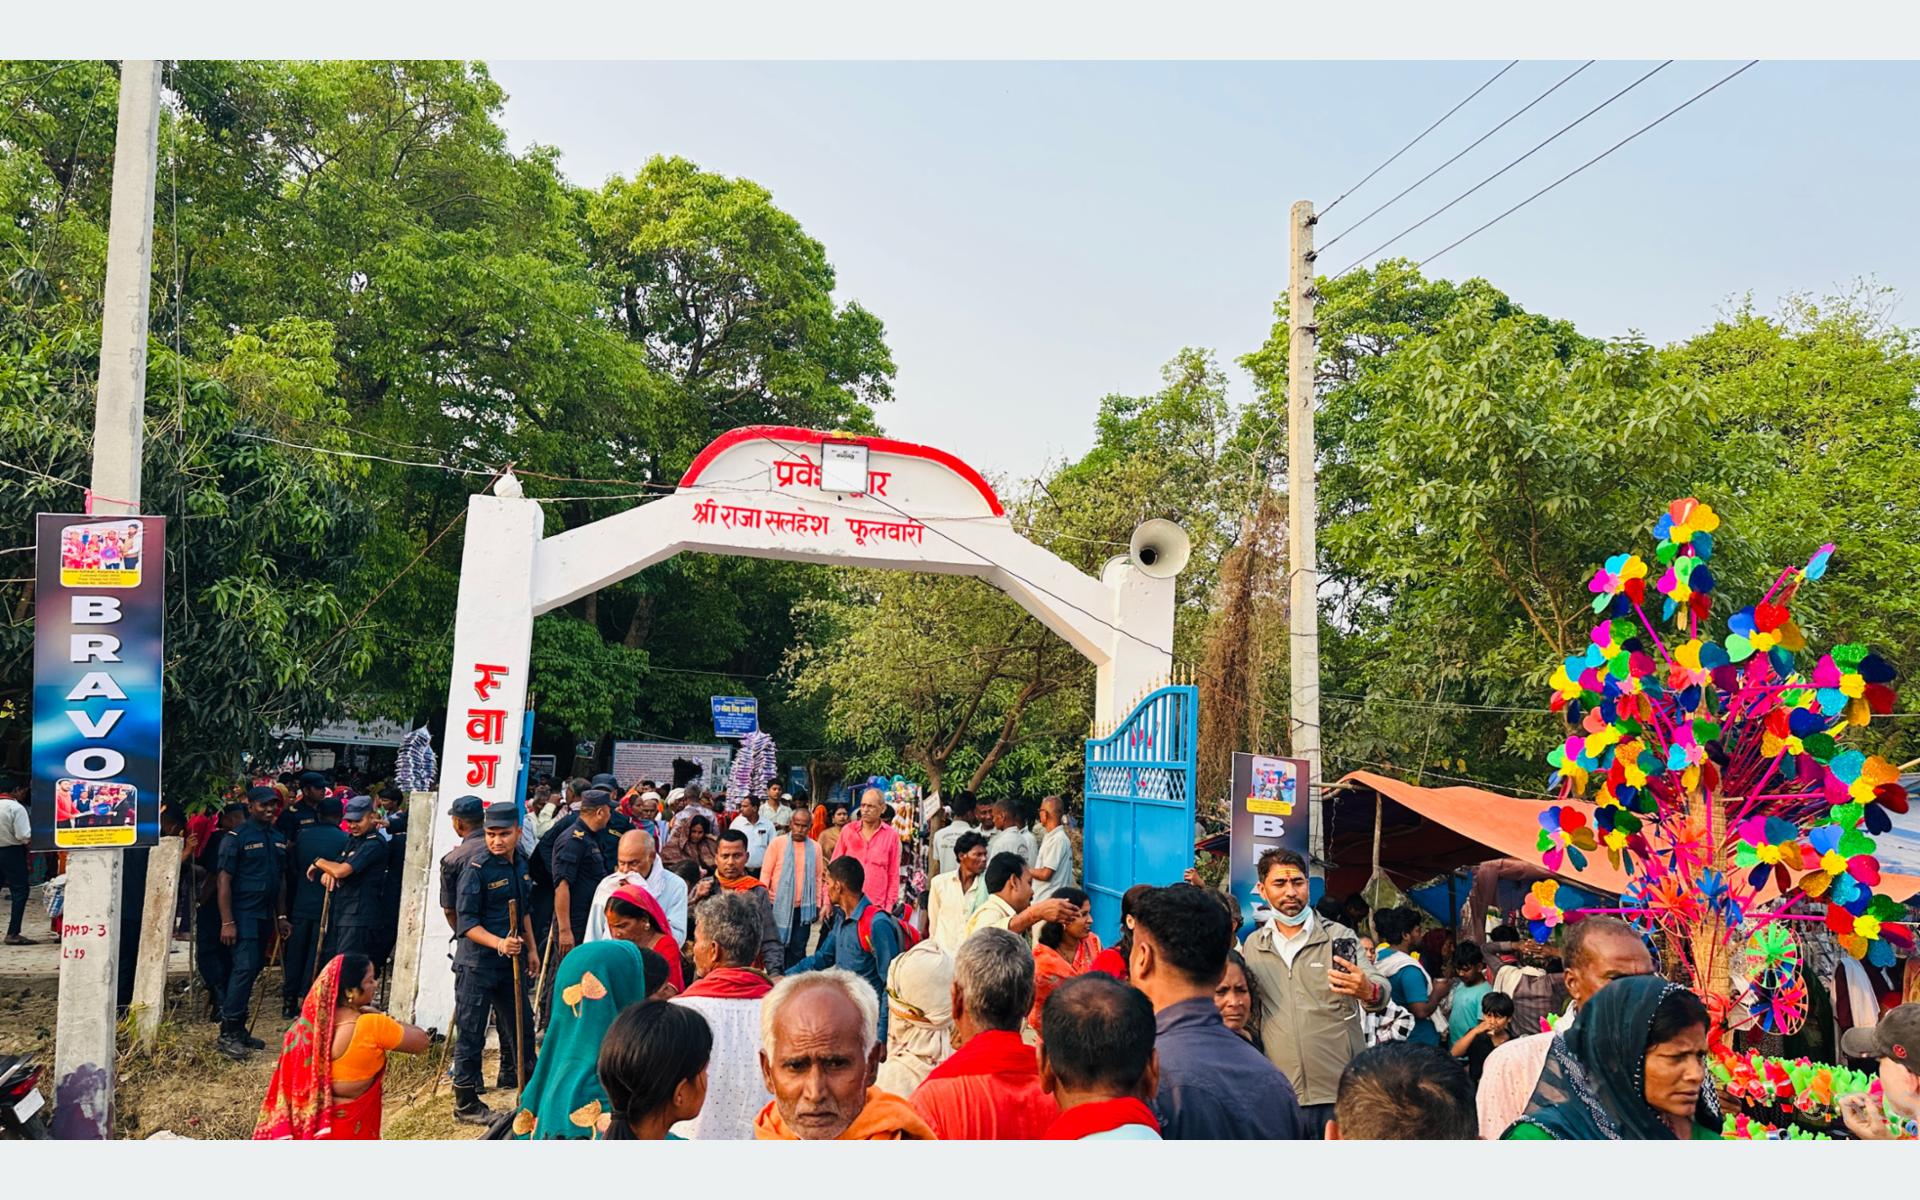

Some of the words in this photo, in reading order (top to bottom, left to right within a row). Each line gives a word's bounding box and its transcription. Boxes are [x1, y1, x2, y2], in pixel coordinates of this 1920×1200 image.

[692, 498, 719, 525] श्री
[721, 505, 762, 530] राजा
[65, 595, 128, 780] BRAVO
[97, 924, 106, 938] 3
